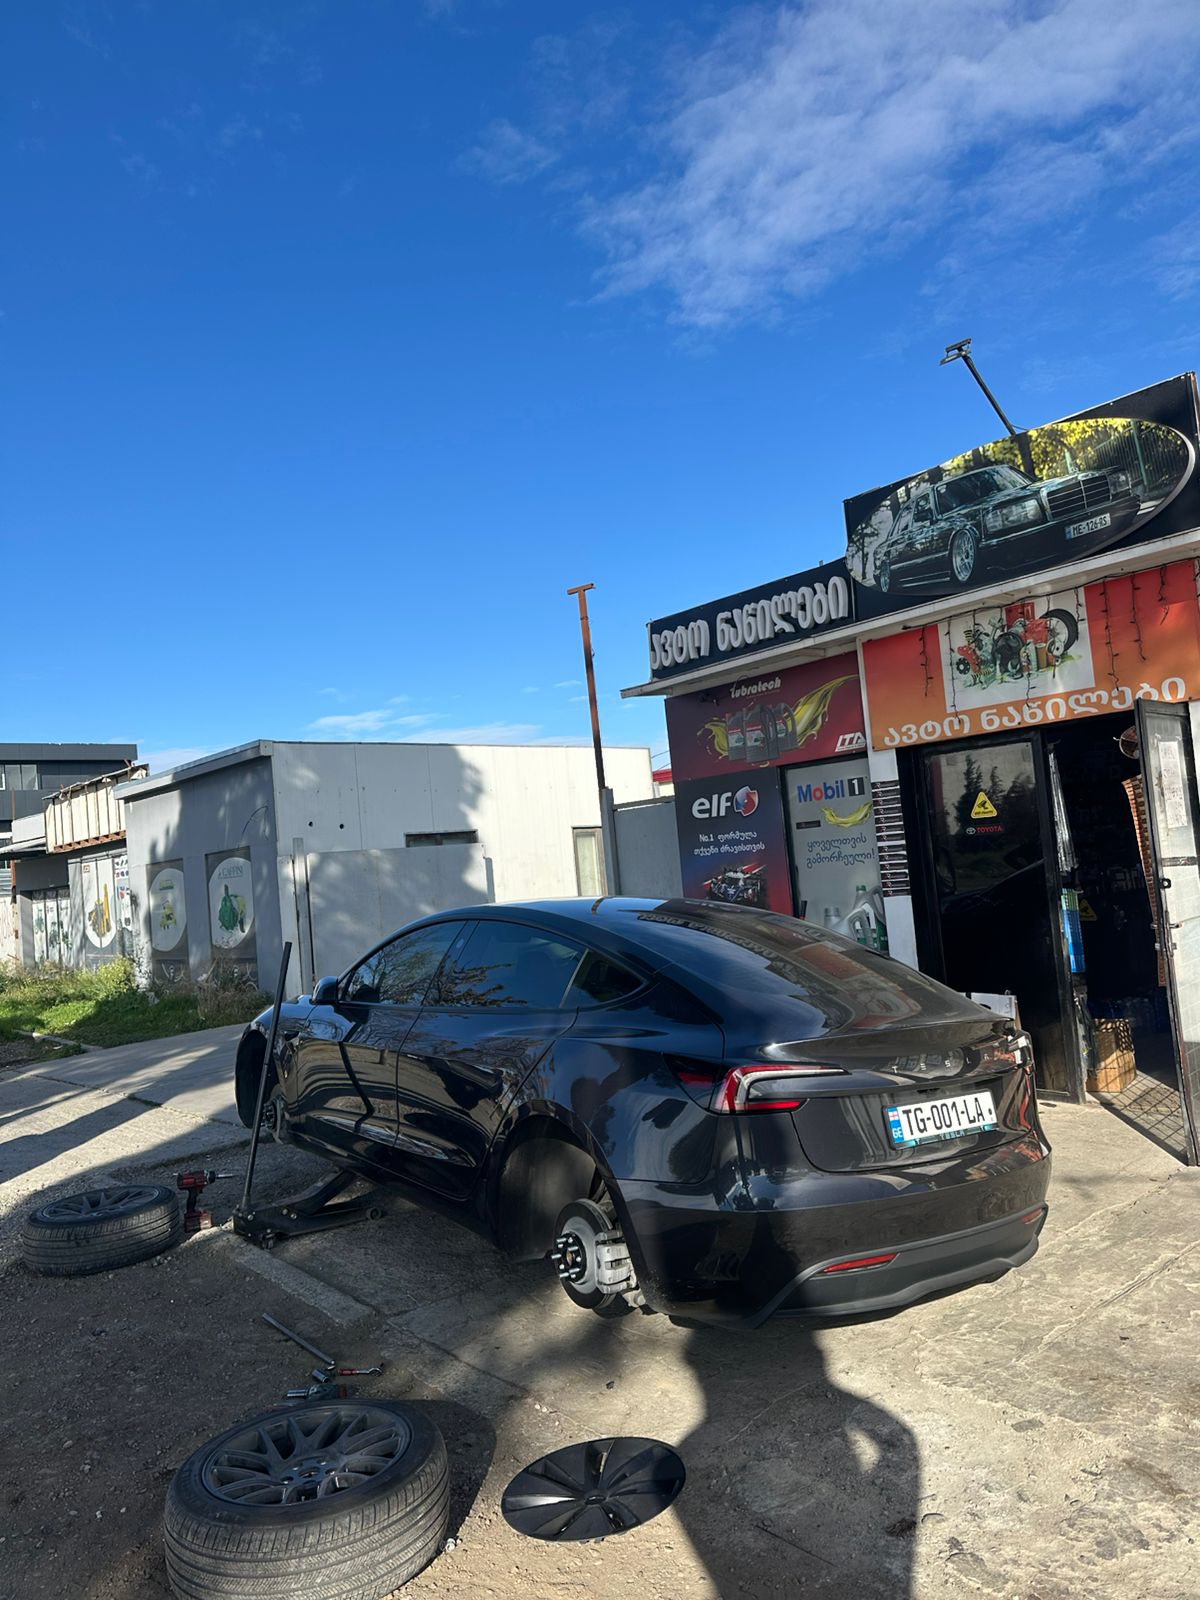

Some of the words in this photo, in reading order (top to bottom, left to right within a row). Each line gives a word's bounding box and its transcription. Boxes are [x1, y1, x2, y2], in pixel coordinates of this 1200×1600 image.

[651, 619, 711, 671] ავტო
[716, 575, 849, 652] ნაწილები
[884, 716, 971, 747] ავტო
[981, 677, 1187, 731] ნაწილები
[796, 780, 845, 803] Mobil
[850, 778, 861, 796] 1
[691, 792, 733, 819] elf
[807, 832, 867, 853] ყოველთვის
[806, 848, 875, 869] გამორჩეული!
[892, 1128, 902, 1138] GE
[902, 1097, 986, 1136] TG-001-LA
